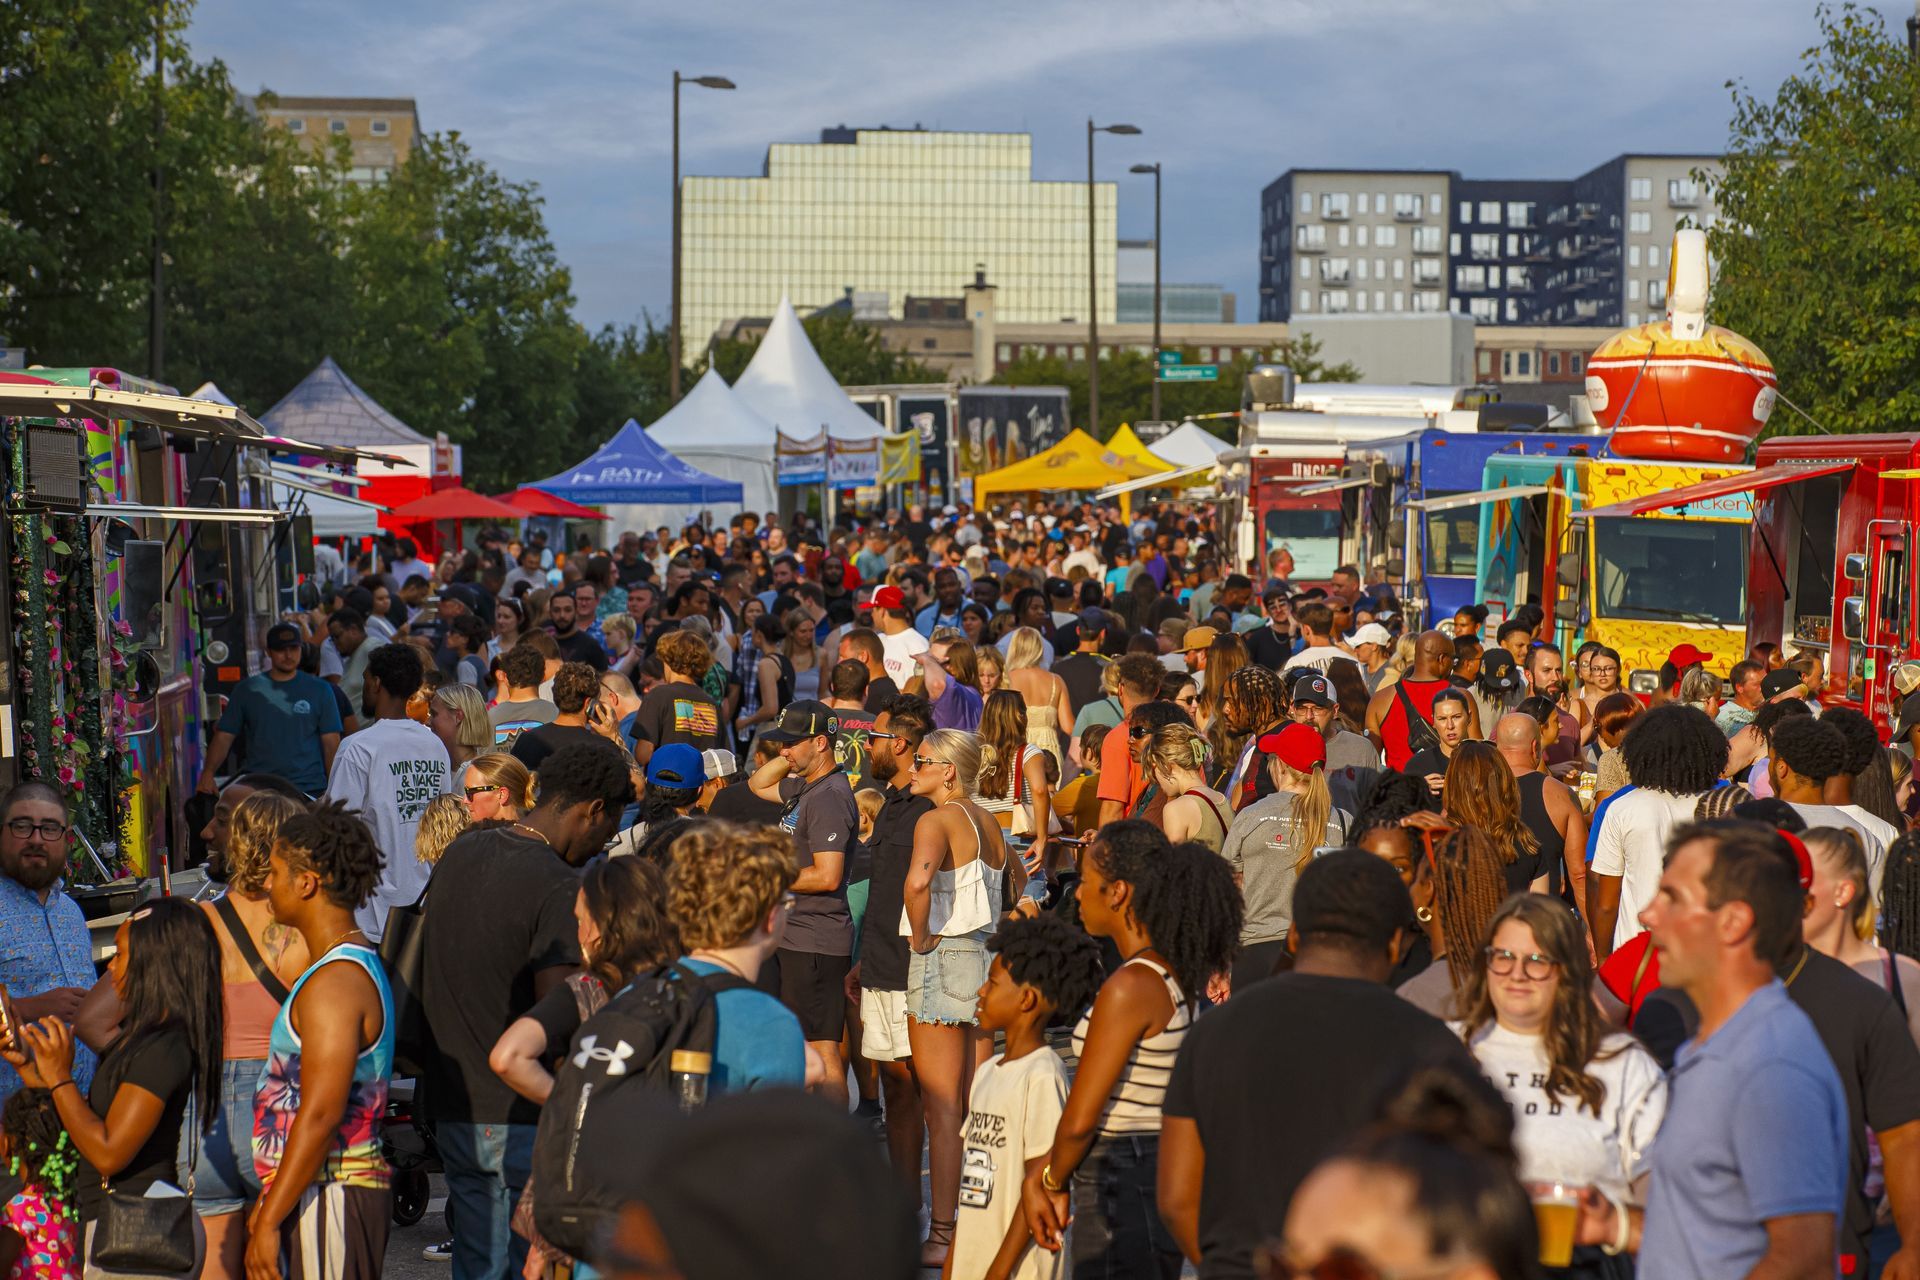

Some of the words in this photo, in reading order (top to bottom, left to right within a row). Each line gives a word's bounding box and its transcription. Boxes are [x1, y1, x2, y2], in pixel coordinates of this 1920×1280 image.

[389, 760, 413, 775] WIN
[414, 760, 446, 774] SOULS
[401, 775, 411, 787] &
[412, 774, 440, 787] MAKE
